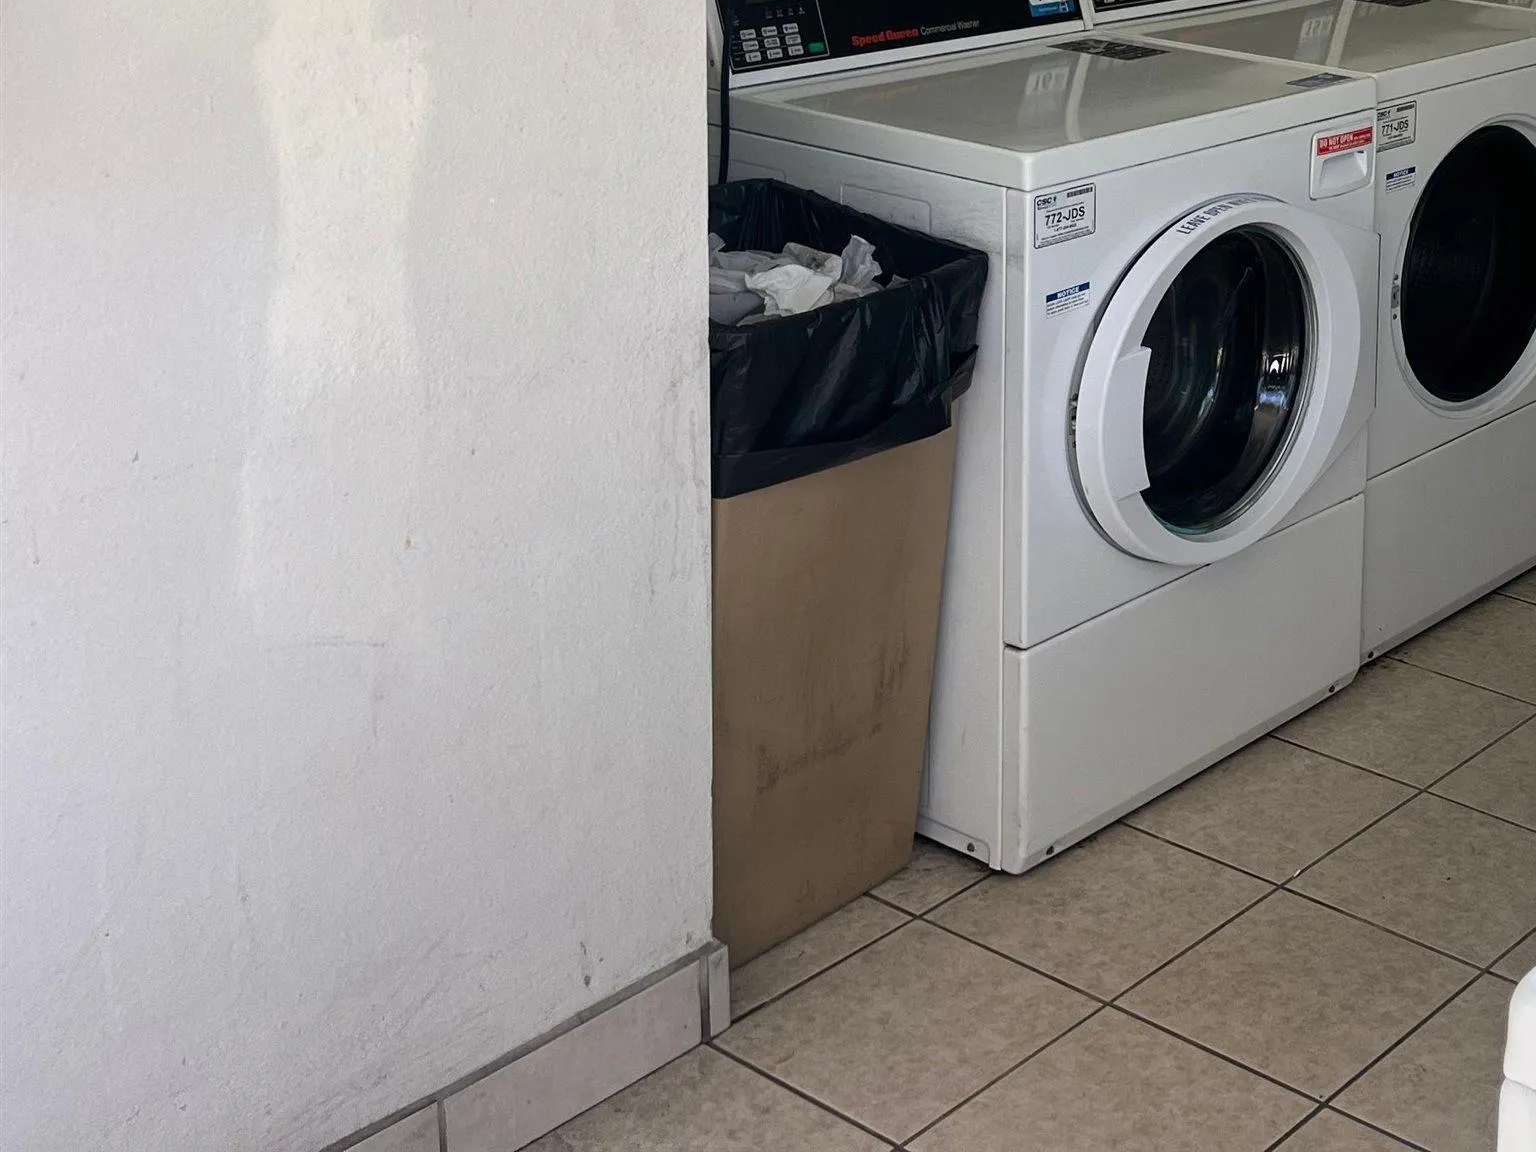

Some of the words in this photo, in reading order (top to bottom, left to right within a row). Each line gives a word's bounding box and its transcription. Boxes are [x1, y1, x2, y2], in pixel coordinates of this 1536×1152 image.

[851, 32, 886, 47] Speed
[886, 28, 919, 41] Queen
[1045, 206, 1085, 226] 772-JDS
[1176, 214, 1211, 235] LEAVE
[1057, 286, 1080, 298] NOTICE
